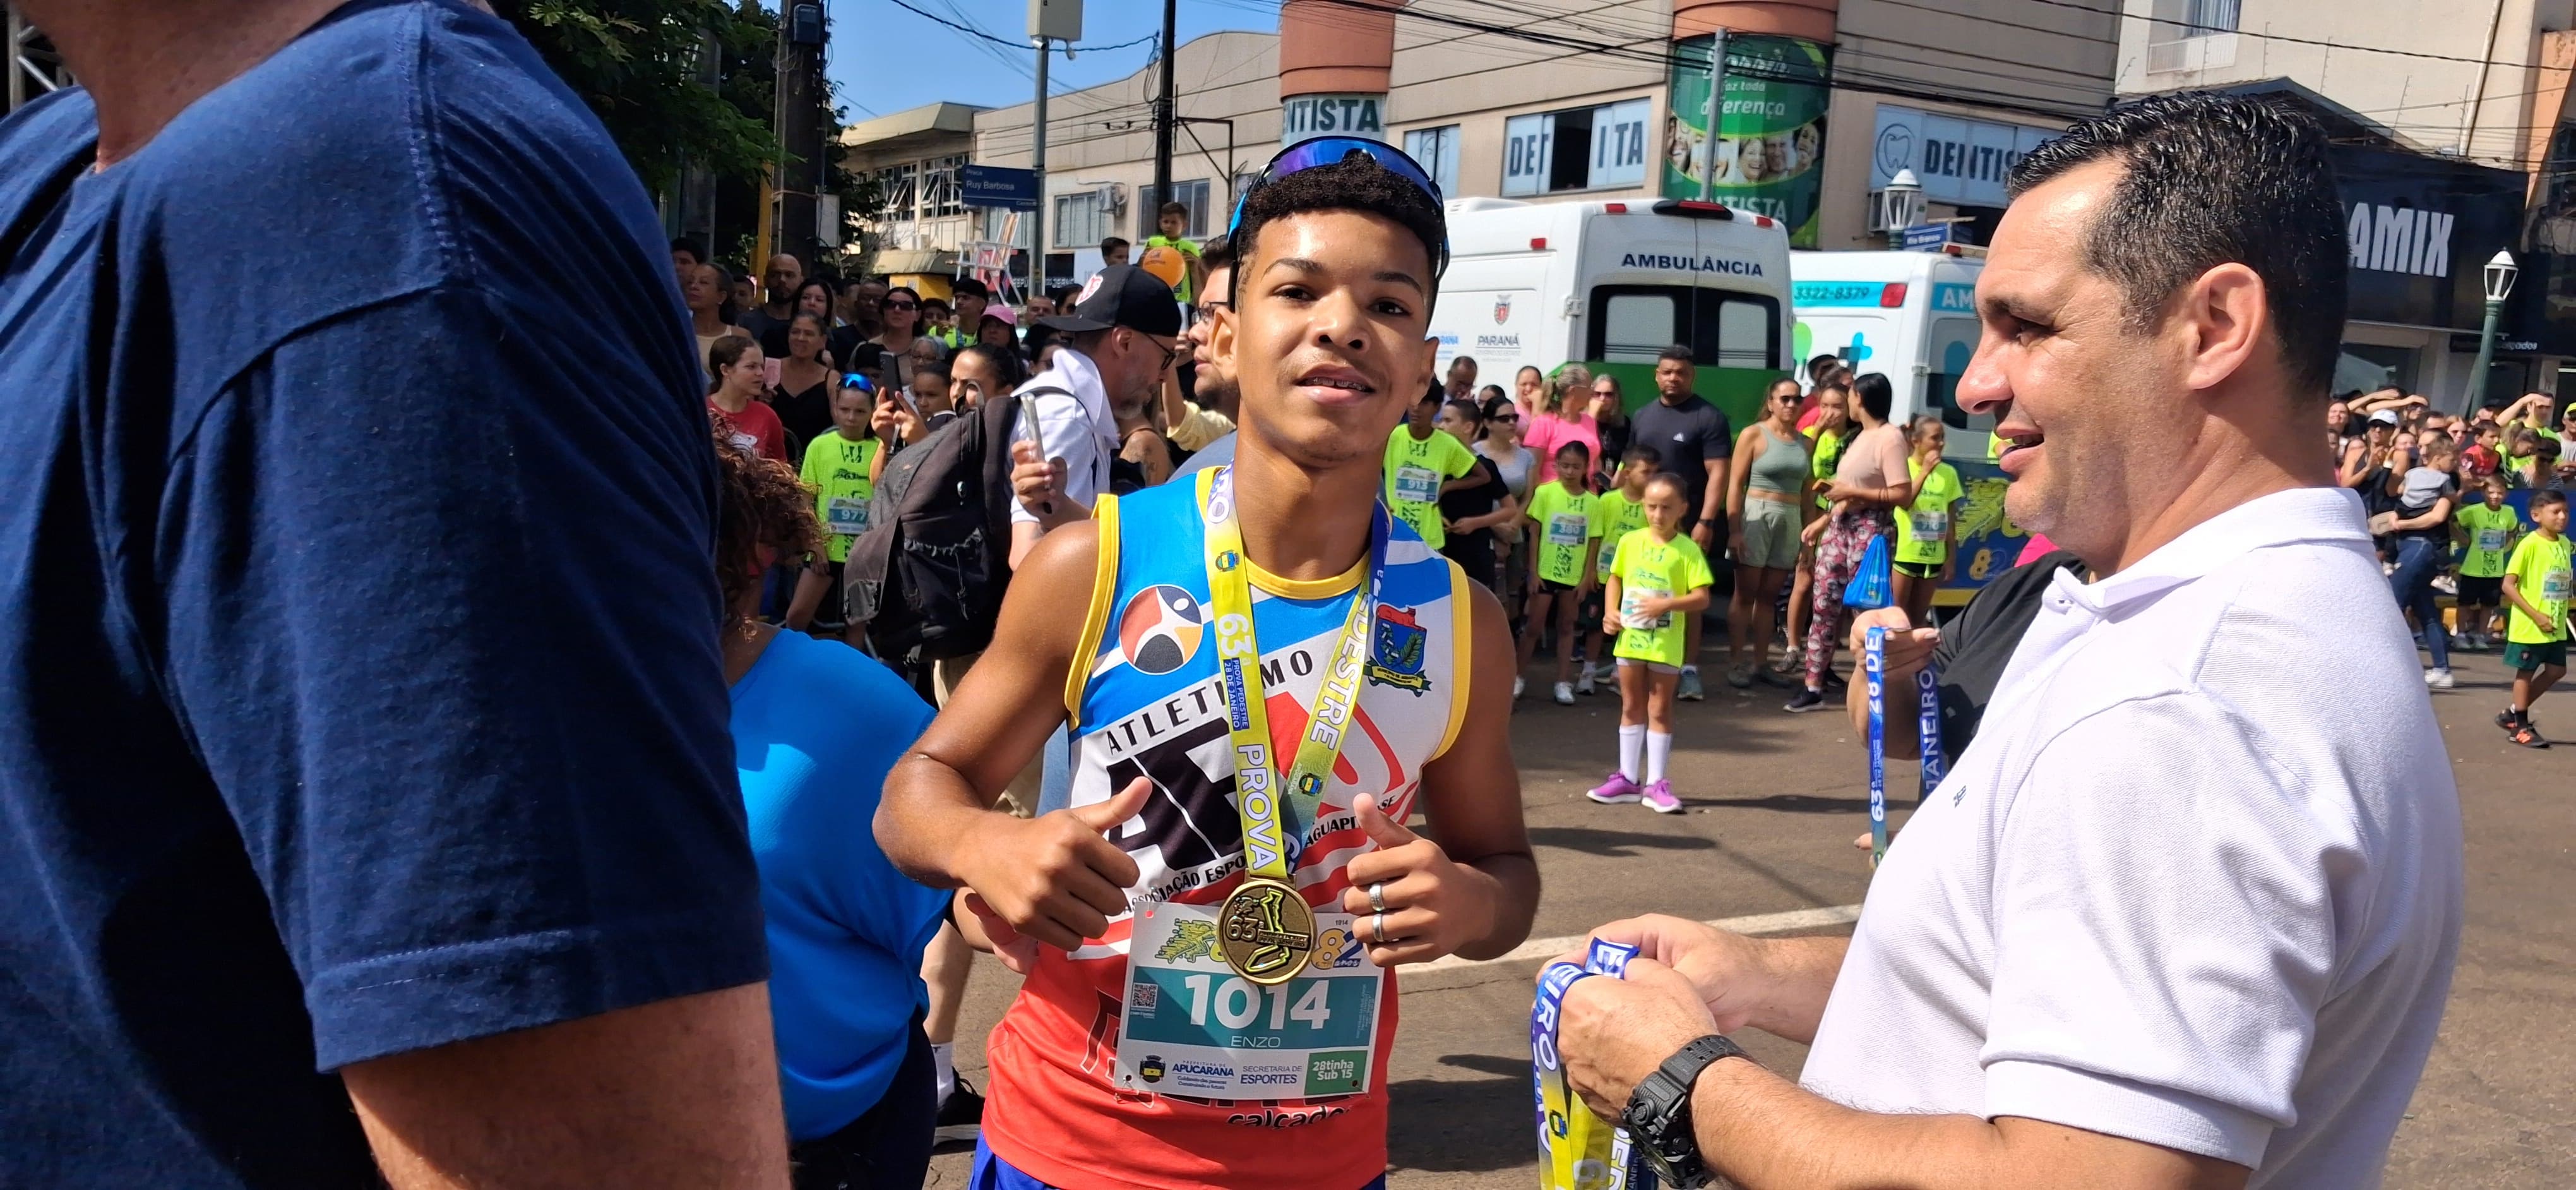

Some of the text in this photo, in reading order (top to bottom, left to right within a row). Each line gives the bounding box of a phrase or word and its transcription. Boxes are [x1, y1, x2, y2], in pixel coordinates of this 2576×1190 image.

[1740, 80, 1766, 92] toda
[966, 181, 1015, 191] Ruy Barbosa
[1621, 253, 1763, 277] AMBULÂNCIA
[1794, 285, 1870, 299] 3322-8379
[1477, 333, 1520, 346] PARANÁ
[1407, 480, 1428, 490] 913
[842, 510, 867, 520] 977
[1865, 634, 1882, 673] DE
[1224, 662, 1240, 728] 28 DE JANEIRO
[1232, 659, 1248, 727] PROVA PEDESTRE
[1106, 650, 1313, 755] ATLETIMO
[1919, 669, 1940, 791] JANEIRO
[1237, 743, 1279, 870] PROVA
[1184, 973, 1331, 1030] 1014
[1231, 1036, 1281, 1048] ENZO
[1172, 1063, 1235, 1077] APUCARANA
[1243, 1065, 1290, 1073] SECRETARIA
[1312, 1059, 1354, 1072] 28tinha
[1240, 1074, 1297, 1085] ESPORTES
[1317, 1069, 1353, 1081] Sub 15
